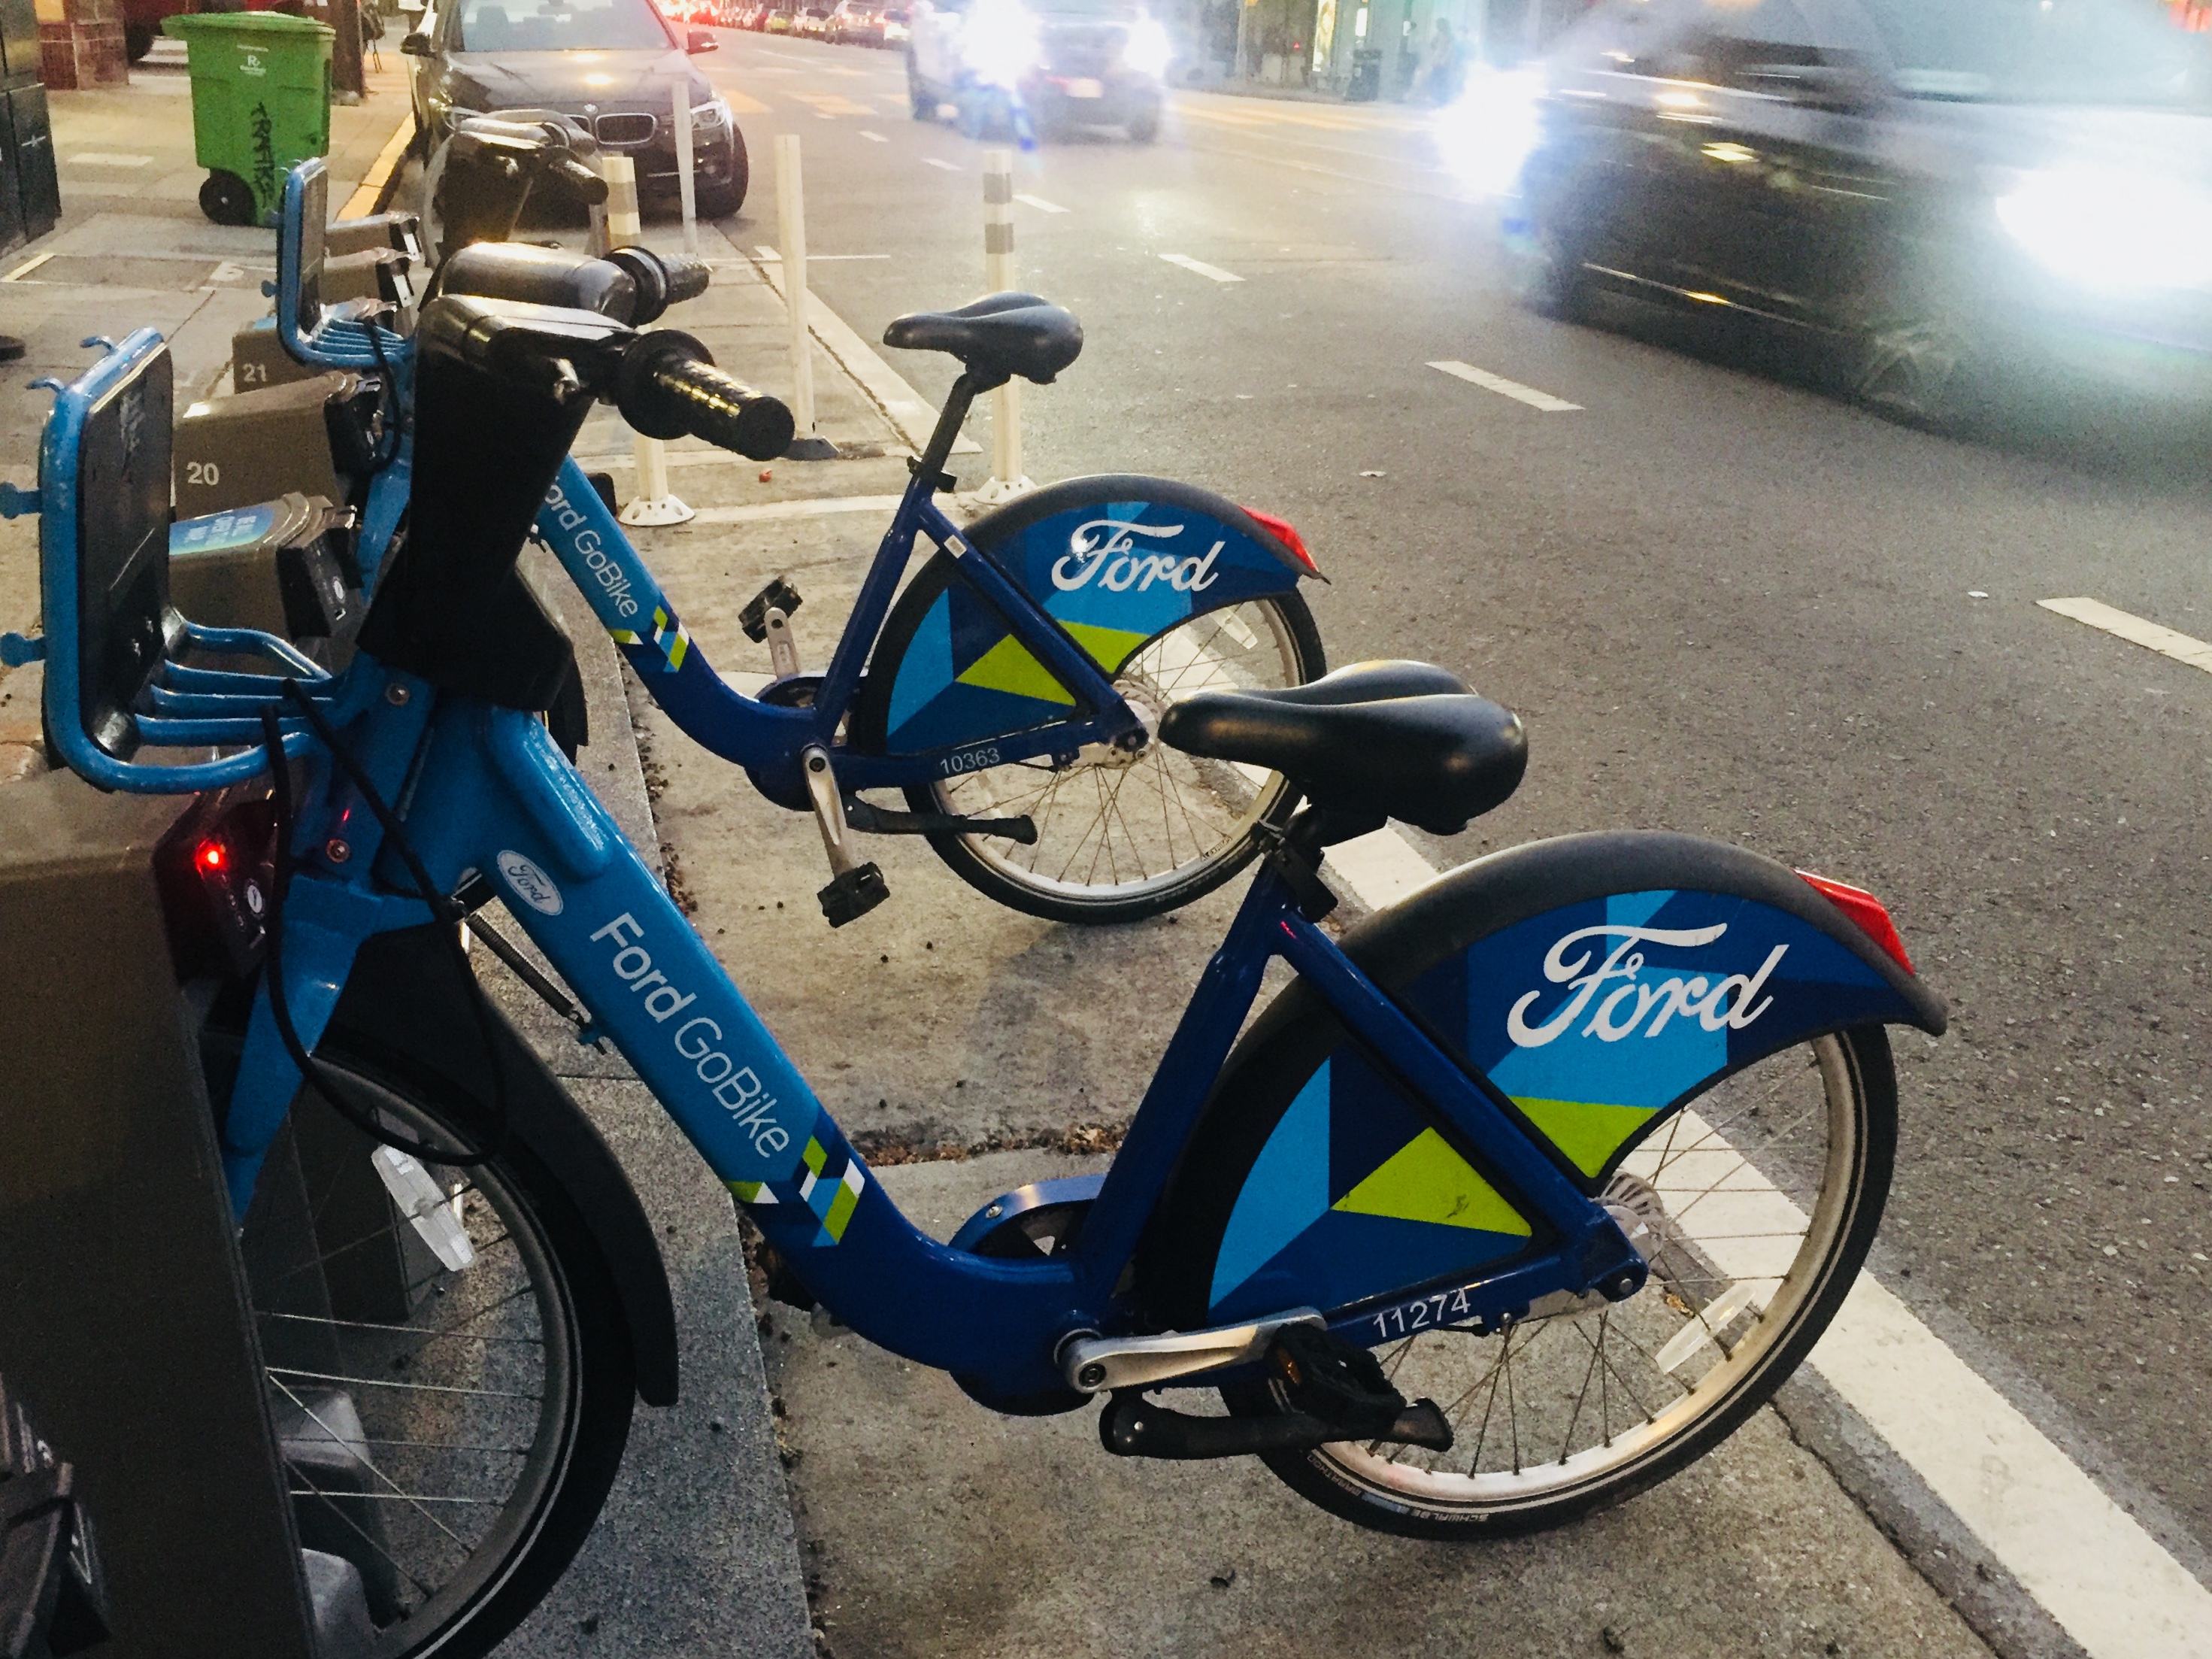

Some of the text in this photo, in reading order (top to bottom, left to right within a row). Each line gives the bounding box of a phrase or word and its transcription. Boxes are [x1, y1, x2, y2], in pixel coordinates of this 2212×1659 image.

[243, 362, 267, 382] 21
[186, 462, 220, 486] 20
[544, 475, 638, 617] ord GoBike
[1051, 520, 1226, 592] Ford
[940, 748, 1000, 775] 10363
[508, 864, 551, 902] Ford
[1507, 922, 1789, 1048] Ford
[590, 912, 789, 1158] Ford GoBike
[1373, 1288, 1471, 1338] 11274
[1412, 1509, 1489, 1523] SCHWALBE
